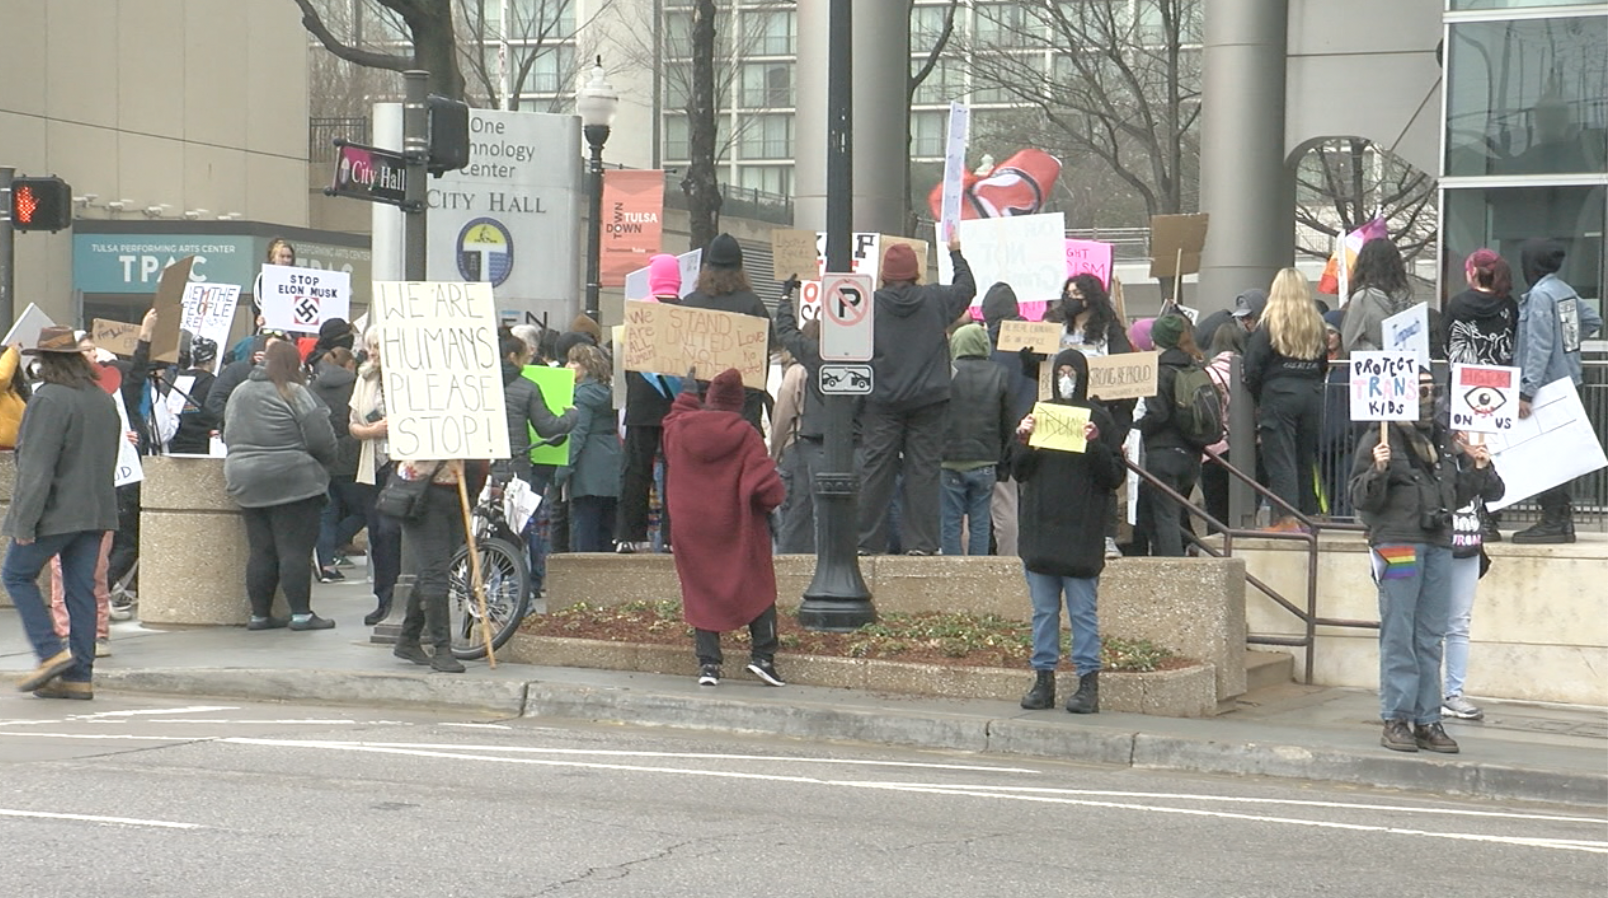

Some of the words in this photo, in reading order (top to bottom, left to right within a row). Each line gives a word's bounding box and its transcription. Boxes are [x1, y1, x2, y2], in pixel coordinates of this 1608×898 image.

[470, 116, 505, 134] One
[469, 141, 535, 162] nology
[352, 160, 378, 191] City
[380, 166, 405, 191] Hall
[427, 188, 475, 210] CITY
[489, 192, 546, 214] HALL
[624, 212, 658, 223] TULSA
[606, 223, 642, 234] DOWN
[91, 243, 119, 253] TULSA
[120, 244, 177, 253] PERFORMING
[178, 244, 199, 253] ARTS
[201, 244, 236, 254] CENTER
[1066, 247, 1090, 259] GHT
[290, 274, 320, 286] STOP
[278, 284, 304, 295] ELON
[310, 287, 338, 298] MUSK
[381, 282, 424, 320] WE
[434, 283, 484, 319] ARE
[669, 309, 732, 335] STAND
[383, 326, 495, 371] HUMANS
[666, 327, 734, 352] UNITED
[682, 345, 721, 367] NOT
[1355, 357, 1414, 377] PROTECT
[389, 373, 496, 414] PLEASE
[1353, 376, 1417, 401] TRANS
[1369, 401, 1405, 416] KIDS
[1453, 413, 1473, 426] ON
[1495, 417, 1512, 430] US
[396, 414, 494, 456] STOP!
